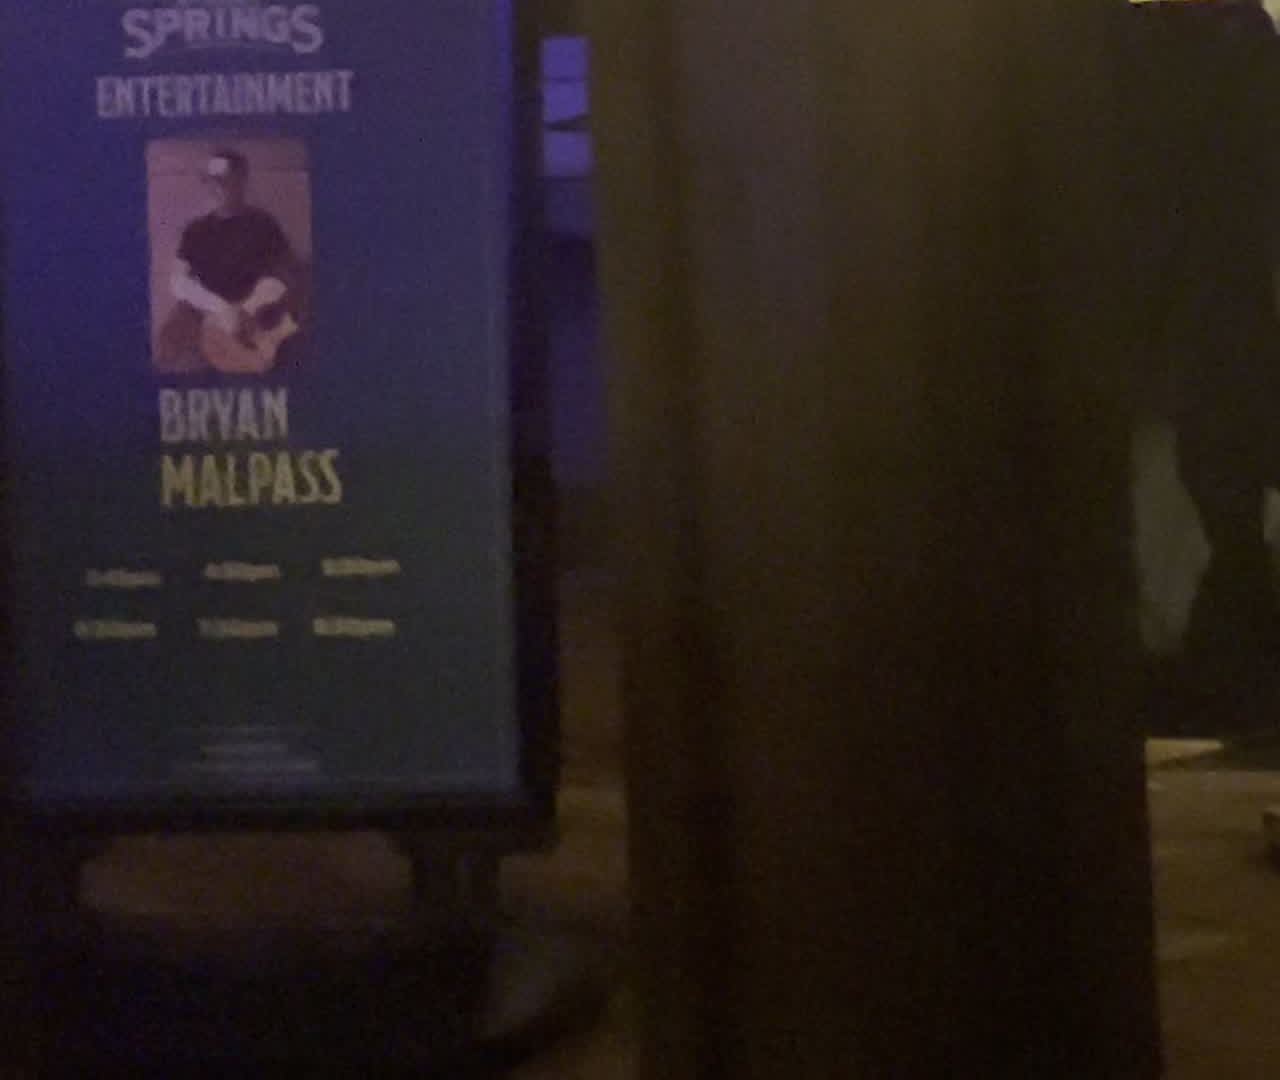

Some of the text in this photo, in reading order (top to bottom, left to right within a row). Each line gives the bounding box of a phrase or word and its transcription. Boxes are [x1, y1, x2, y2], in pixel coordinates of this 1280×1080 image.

[122, 5, 324, 57] SPRINGS
[96, 71, 352, 117] ENTERTAINMENT
[160, 387, 288, 441] BRYAN
[161, 450, 342, 506] MALPASS
